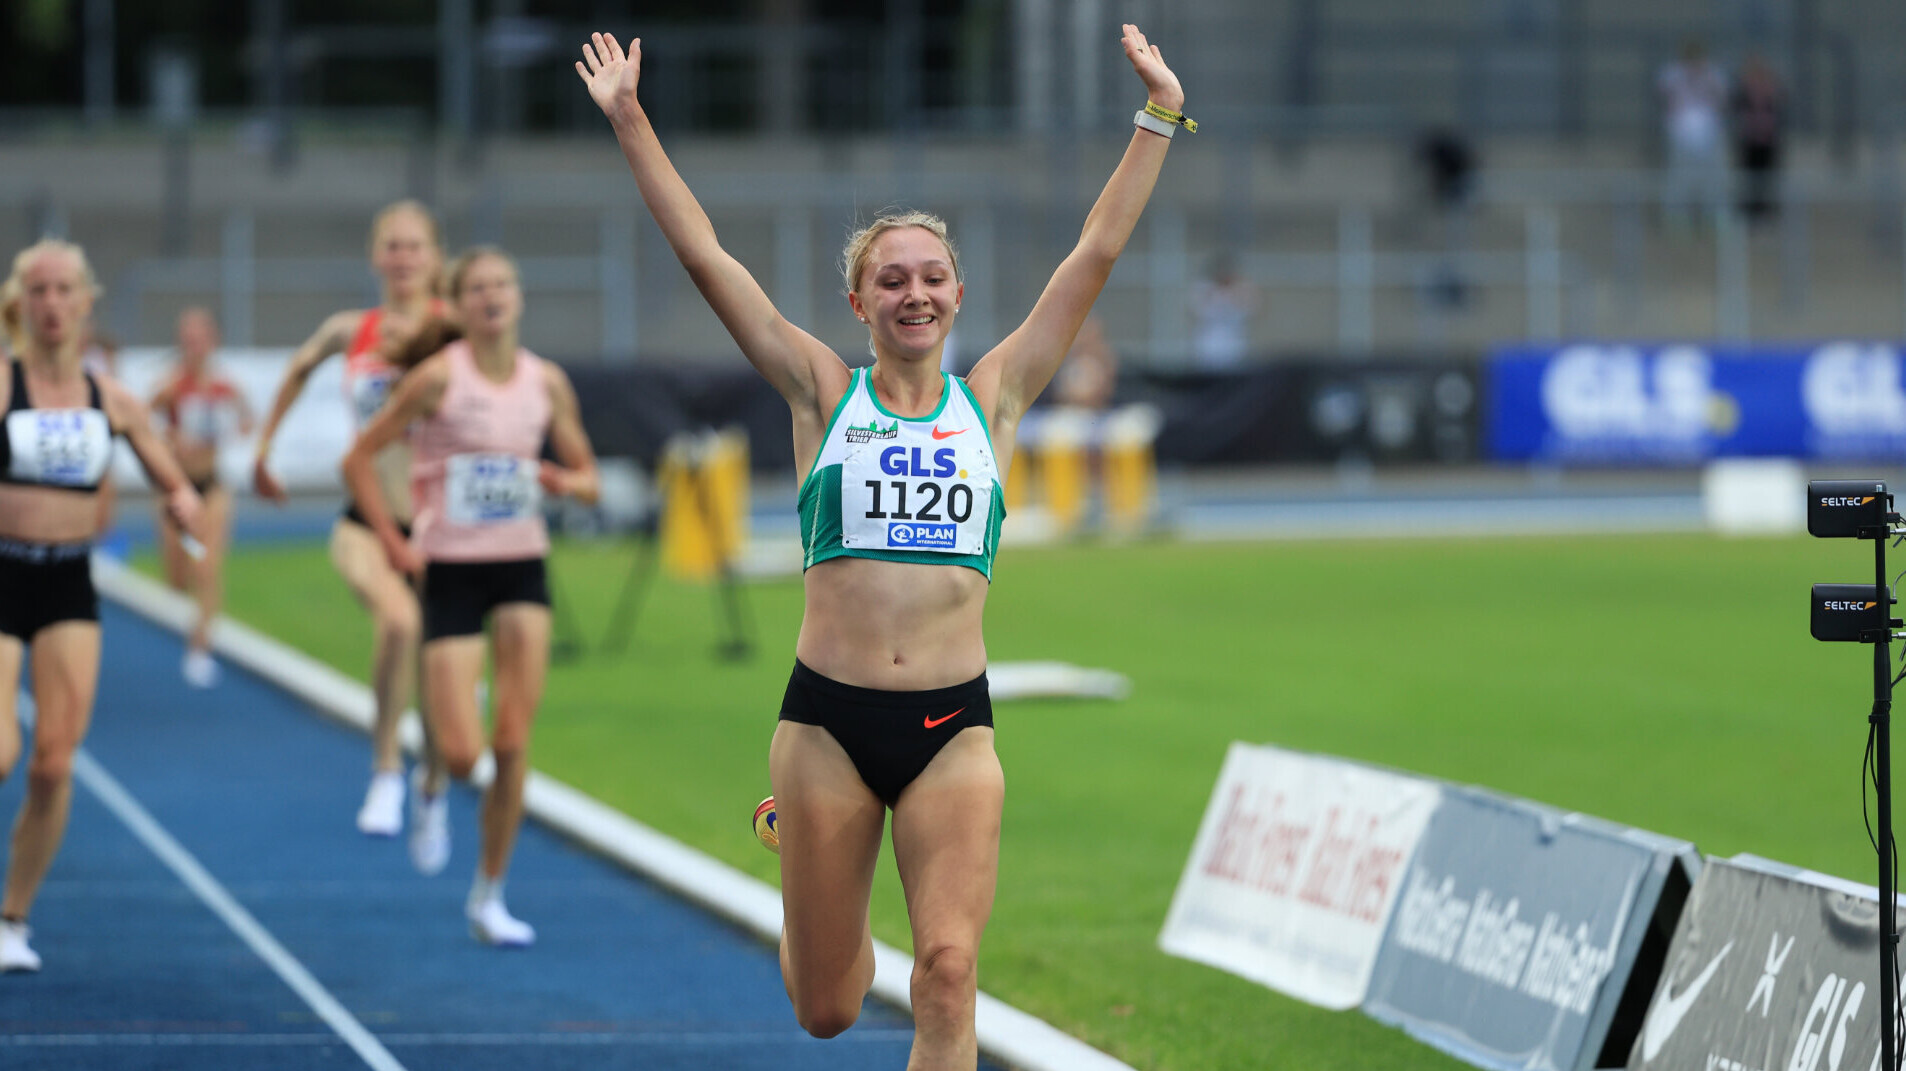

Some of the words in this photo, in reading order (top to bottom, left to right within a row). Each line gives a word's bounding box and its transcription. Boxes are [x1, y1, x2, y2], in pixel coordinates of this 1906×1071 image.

[846, 429, 898, 439] SILVESTERLAUF
[865, 480, 973, 523] 1120
[1821, 497, 1861, 507] SELTEC
[916, 528, 954, 540] PLAN
[1824, 601, 1864, 611] SELTEC
